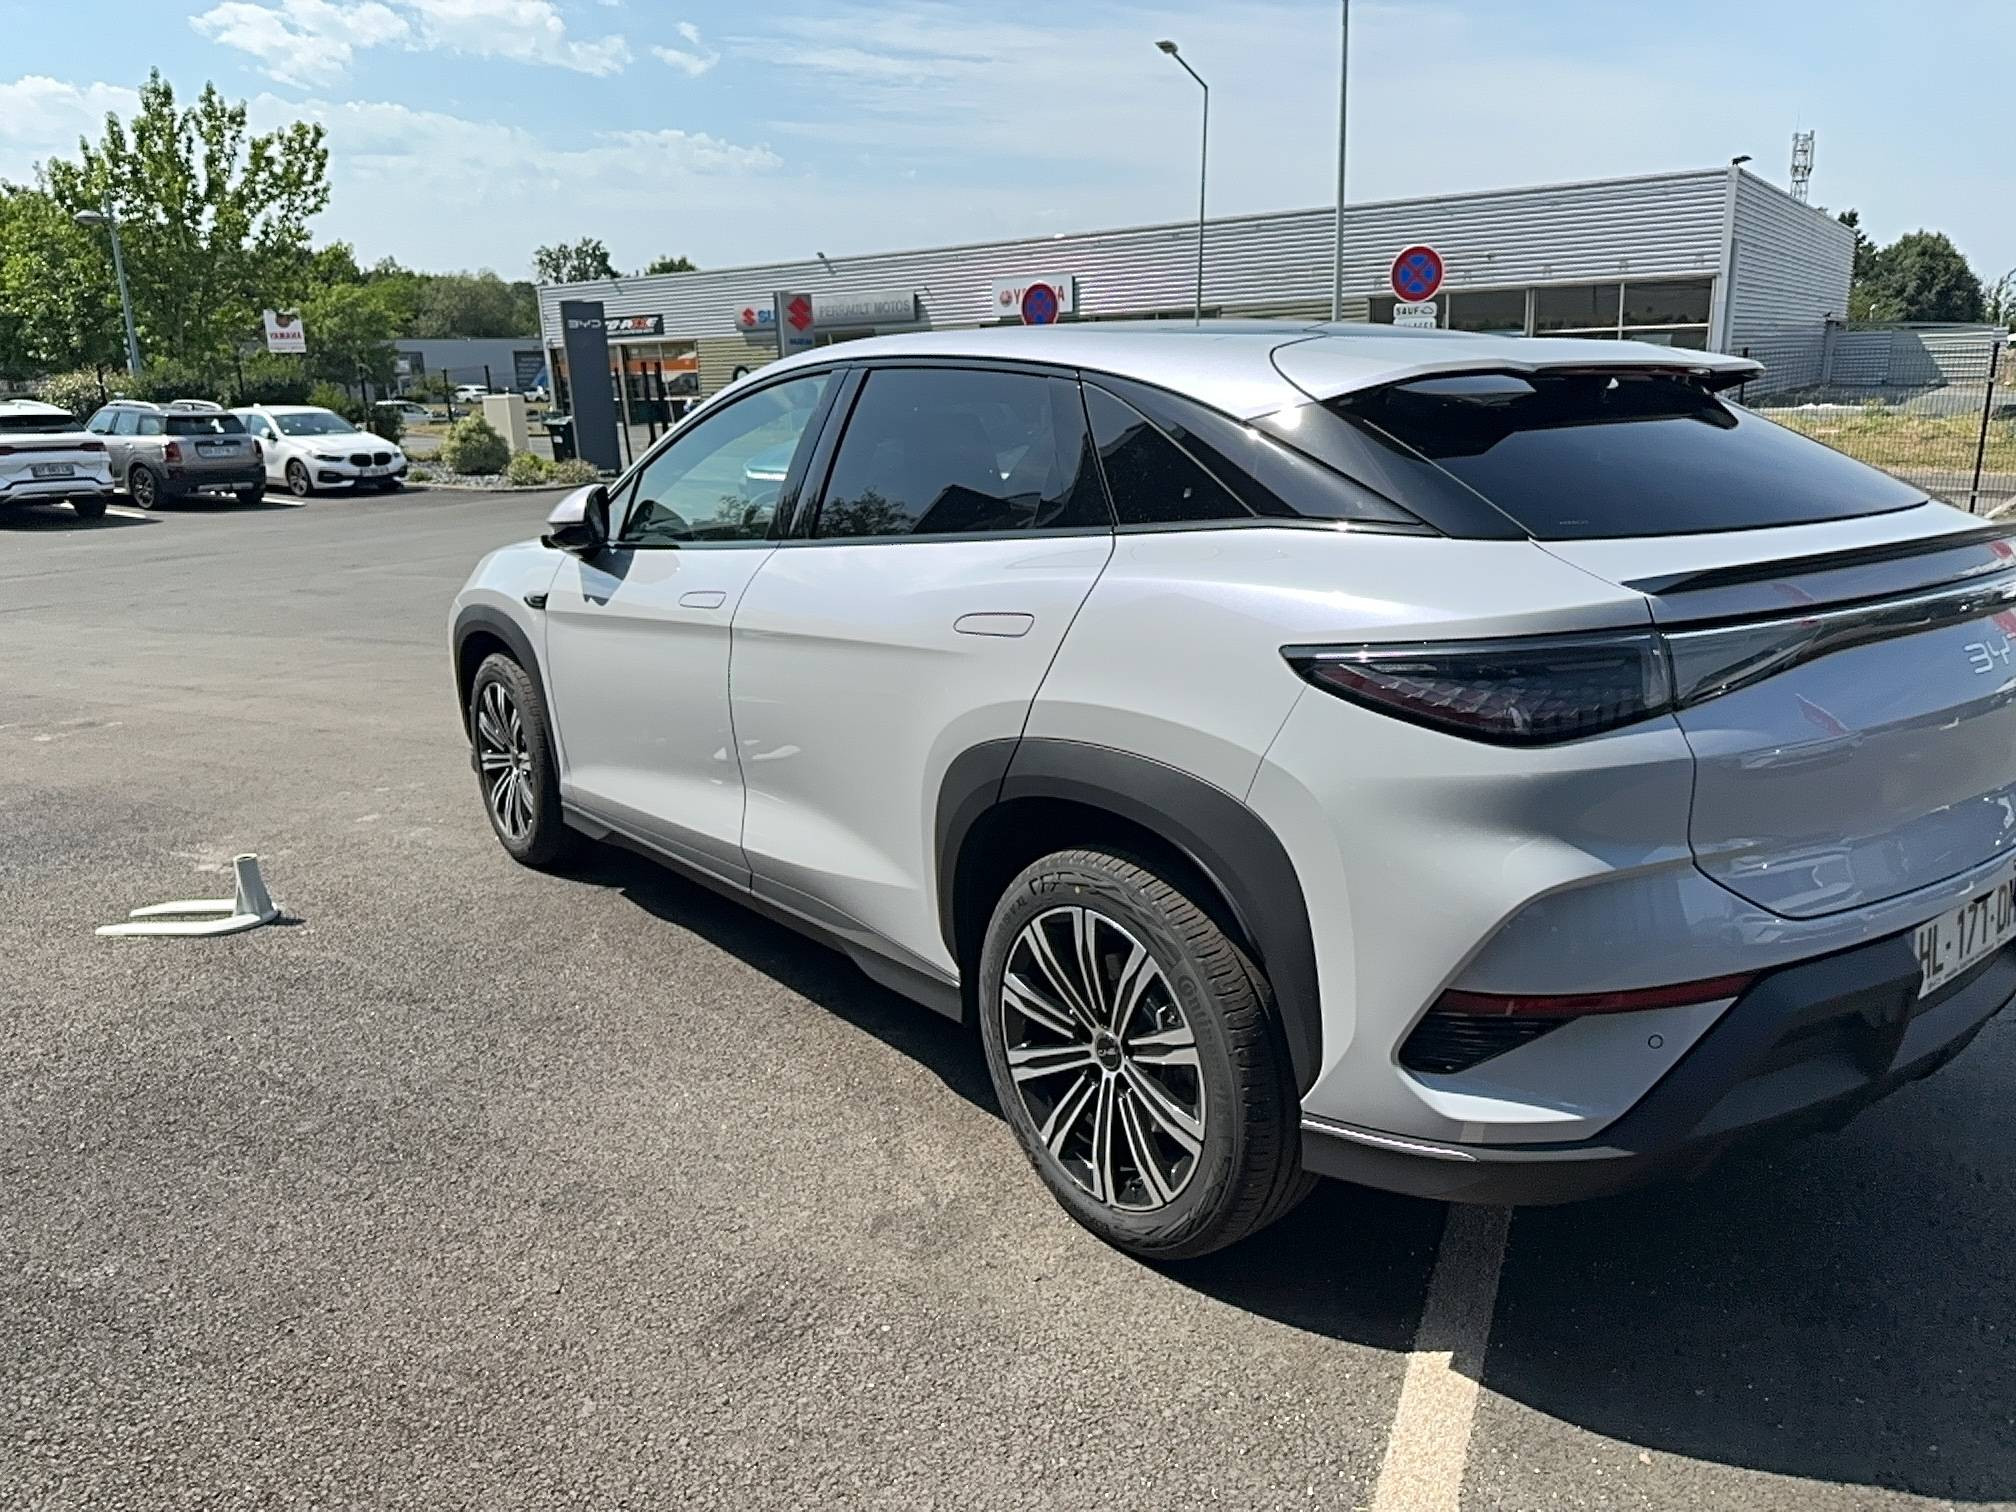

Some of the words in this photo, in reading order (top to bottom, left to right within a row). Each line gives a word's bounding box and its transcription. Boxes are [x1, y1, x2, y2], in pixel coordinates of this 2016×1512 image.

[874, 299, 911, 316] MOTOS
[1396, 306, 1419, 316] SAUF
[567, 319, 602, 329] BYD
[271, 331, 302, 340] YAMAHA
[1963, 632, 2016, 674] BY
